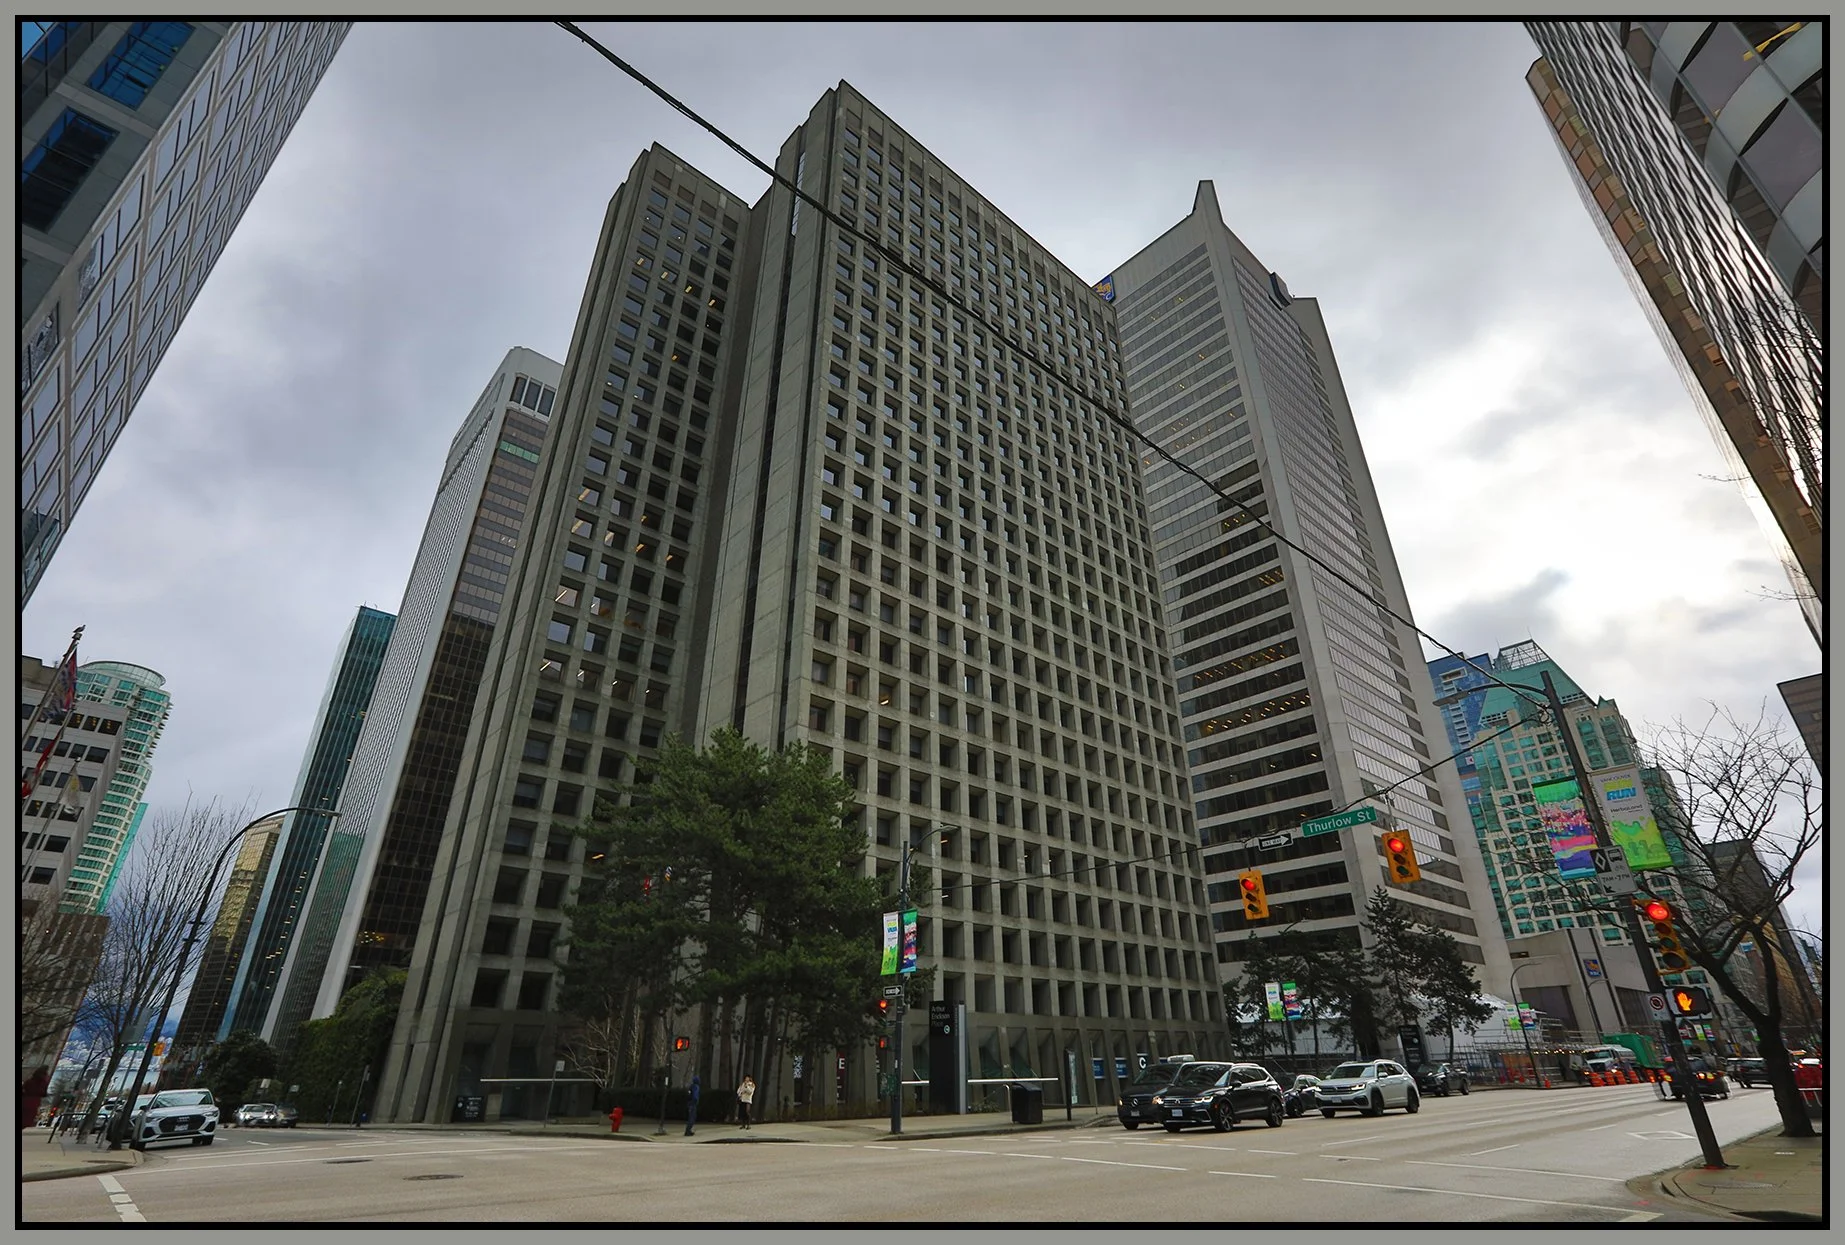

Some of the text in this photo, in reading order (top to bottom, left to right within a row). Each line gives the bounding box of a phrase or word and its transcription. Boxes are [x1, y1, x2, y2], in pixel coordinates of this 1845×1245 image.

[1607, 787, 1637, 801] RUN
[1307, 810, 1371, 833] Thurlow St
